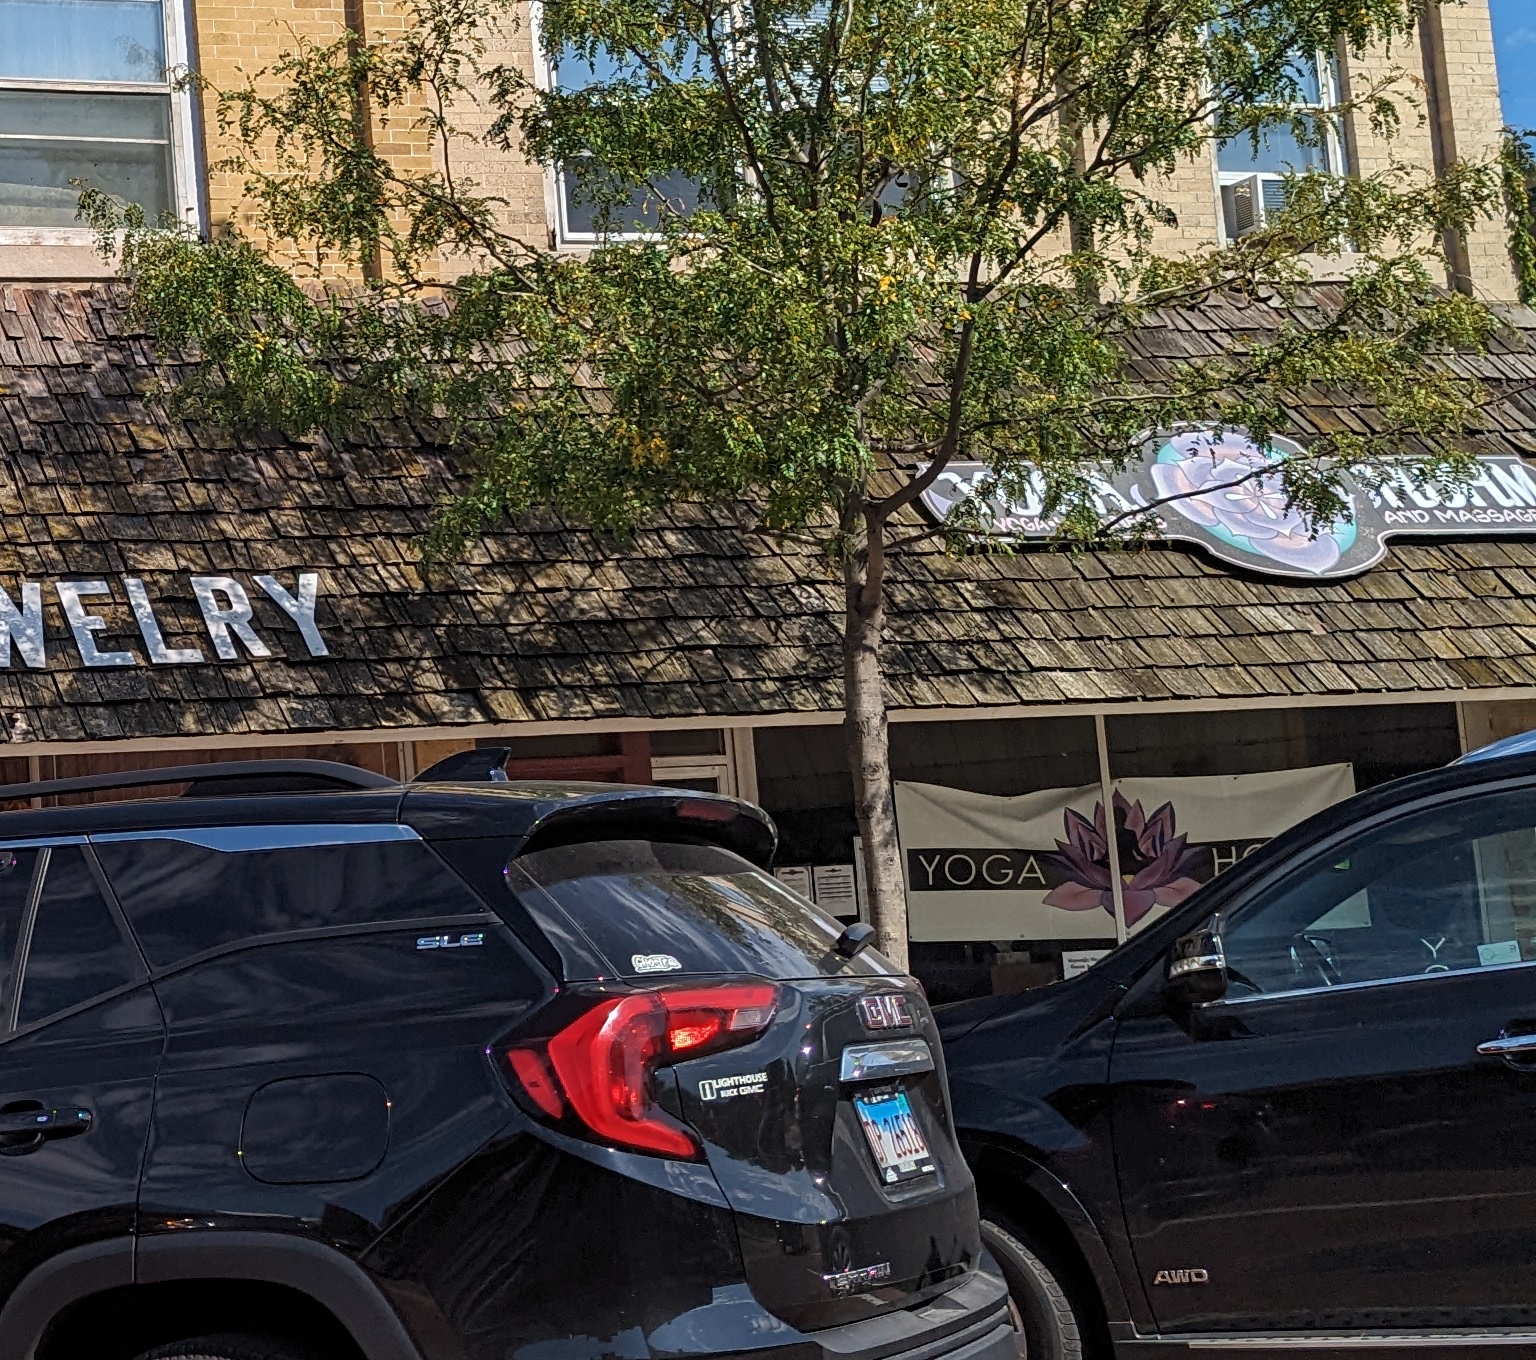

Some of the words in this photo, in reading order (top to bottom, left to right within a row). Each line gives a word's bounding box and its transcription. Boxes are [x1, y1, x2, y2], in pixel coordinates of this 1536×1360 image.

[1384, 509, 1430, 525] AND
[918, 854, 1047, 886] YOGA
[416, 933, 484, 950] SLE
[856, 994, 914, 1030] GMC
[712, 1072, 769, 1089] LIGHTHOUSE
[1153, 1268, 1209, 1285] AWD
